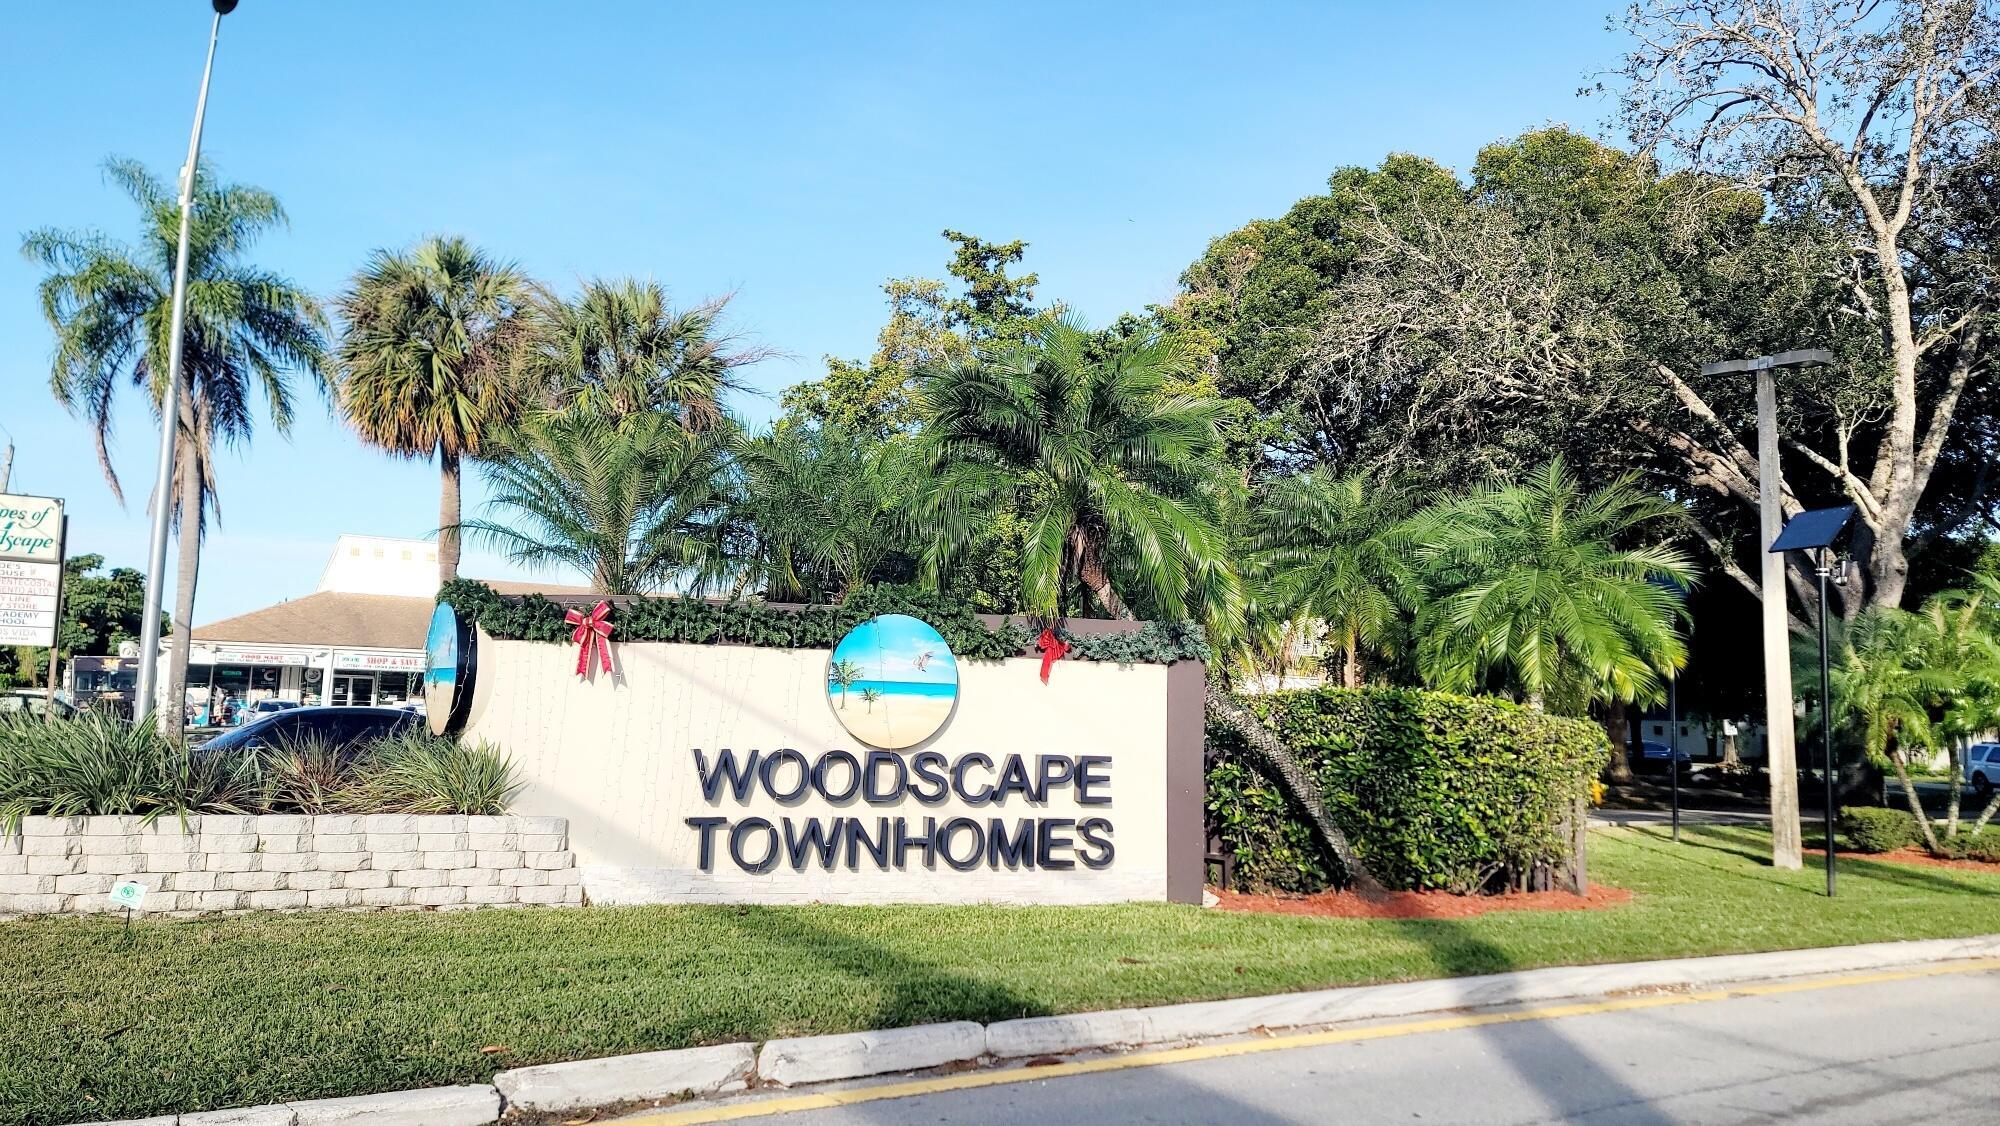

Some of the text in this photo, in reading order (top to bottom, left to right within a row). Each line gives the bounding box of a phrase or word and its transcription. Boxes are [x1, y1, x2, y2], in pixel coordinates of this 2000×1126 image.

[18, 506, 55, 529] of
[0, 611, 40, 619] ADEMY
[367, 657, 388, 665] SHOP
[692, 749, 1112, 804] WOODSCAPE
[685, 816, 1115, 871] TOWNHOMES
